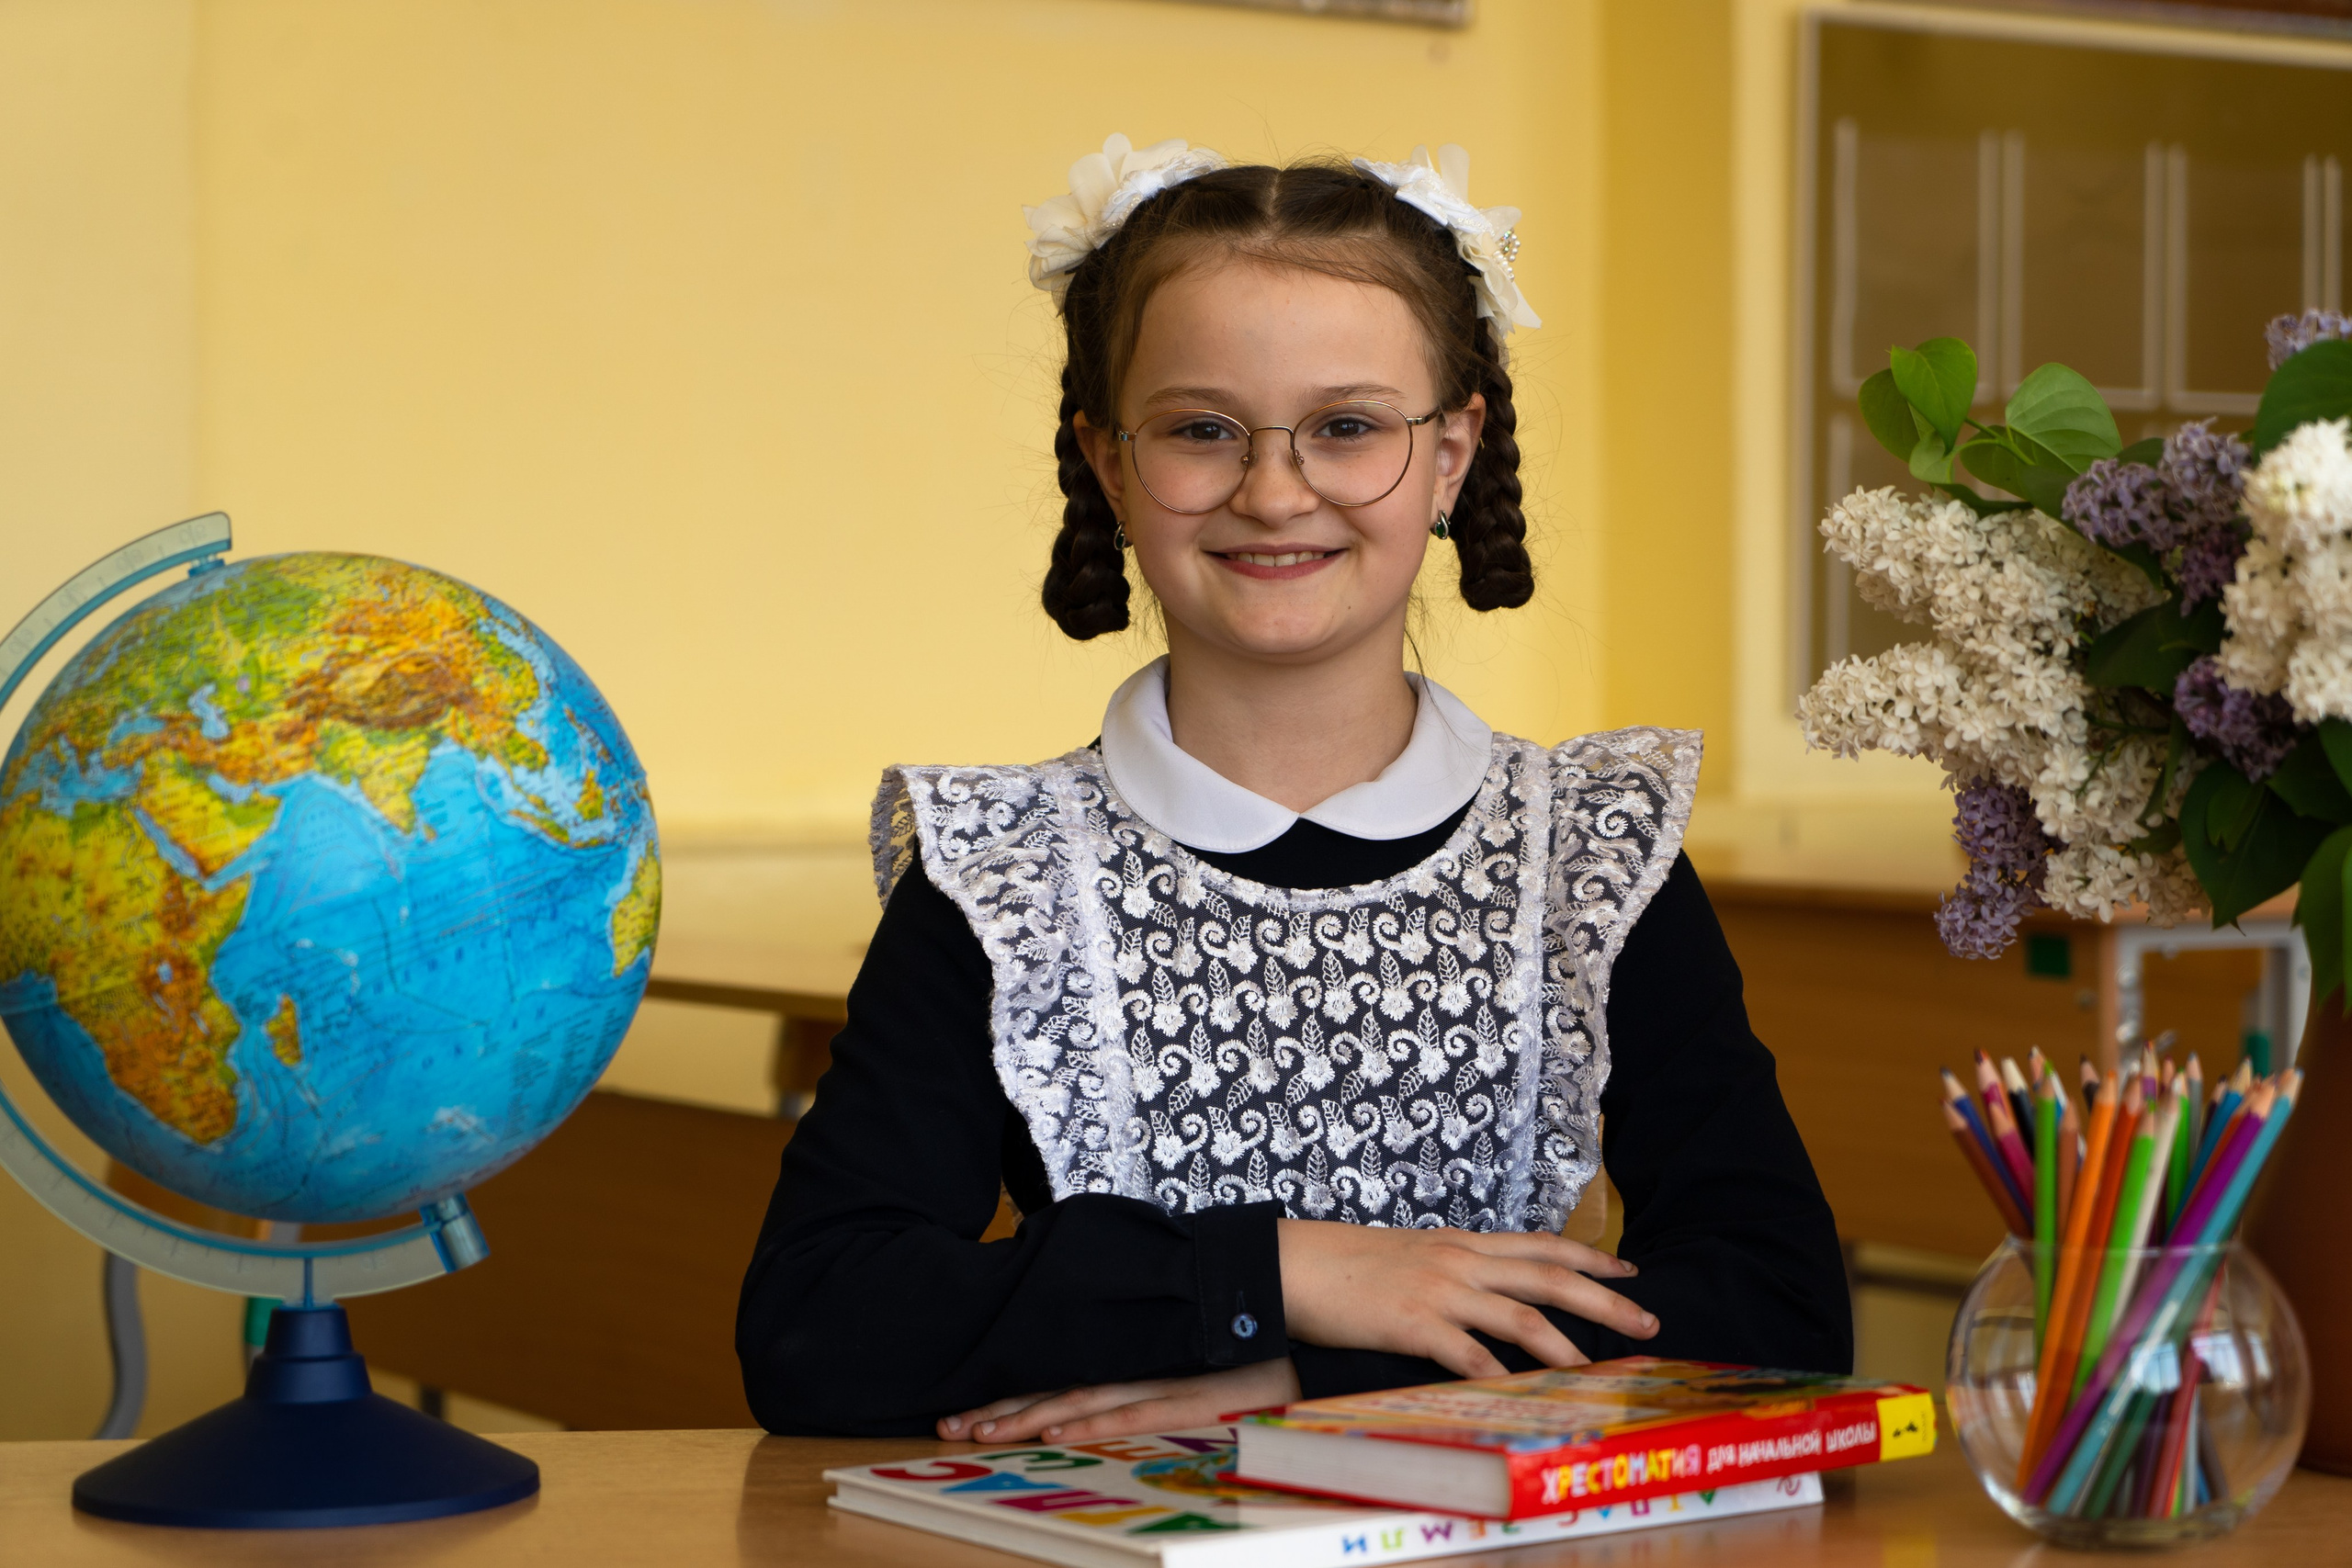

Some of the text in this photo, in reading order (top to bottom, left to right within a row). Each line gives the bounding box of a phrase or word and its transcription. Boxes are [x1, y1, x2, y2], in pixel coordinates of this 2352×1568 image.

[869, 1461, 1262, 1535] АТЛАС
[1541, 1444, 1701, 1505] ХРЕСТОМАТИЯ
[1737, 1428, 1823, 1468] НАЧАЛЬНОЙ
[1825, 1421, 1877, 1453] ШКОЛЫ
